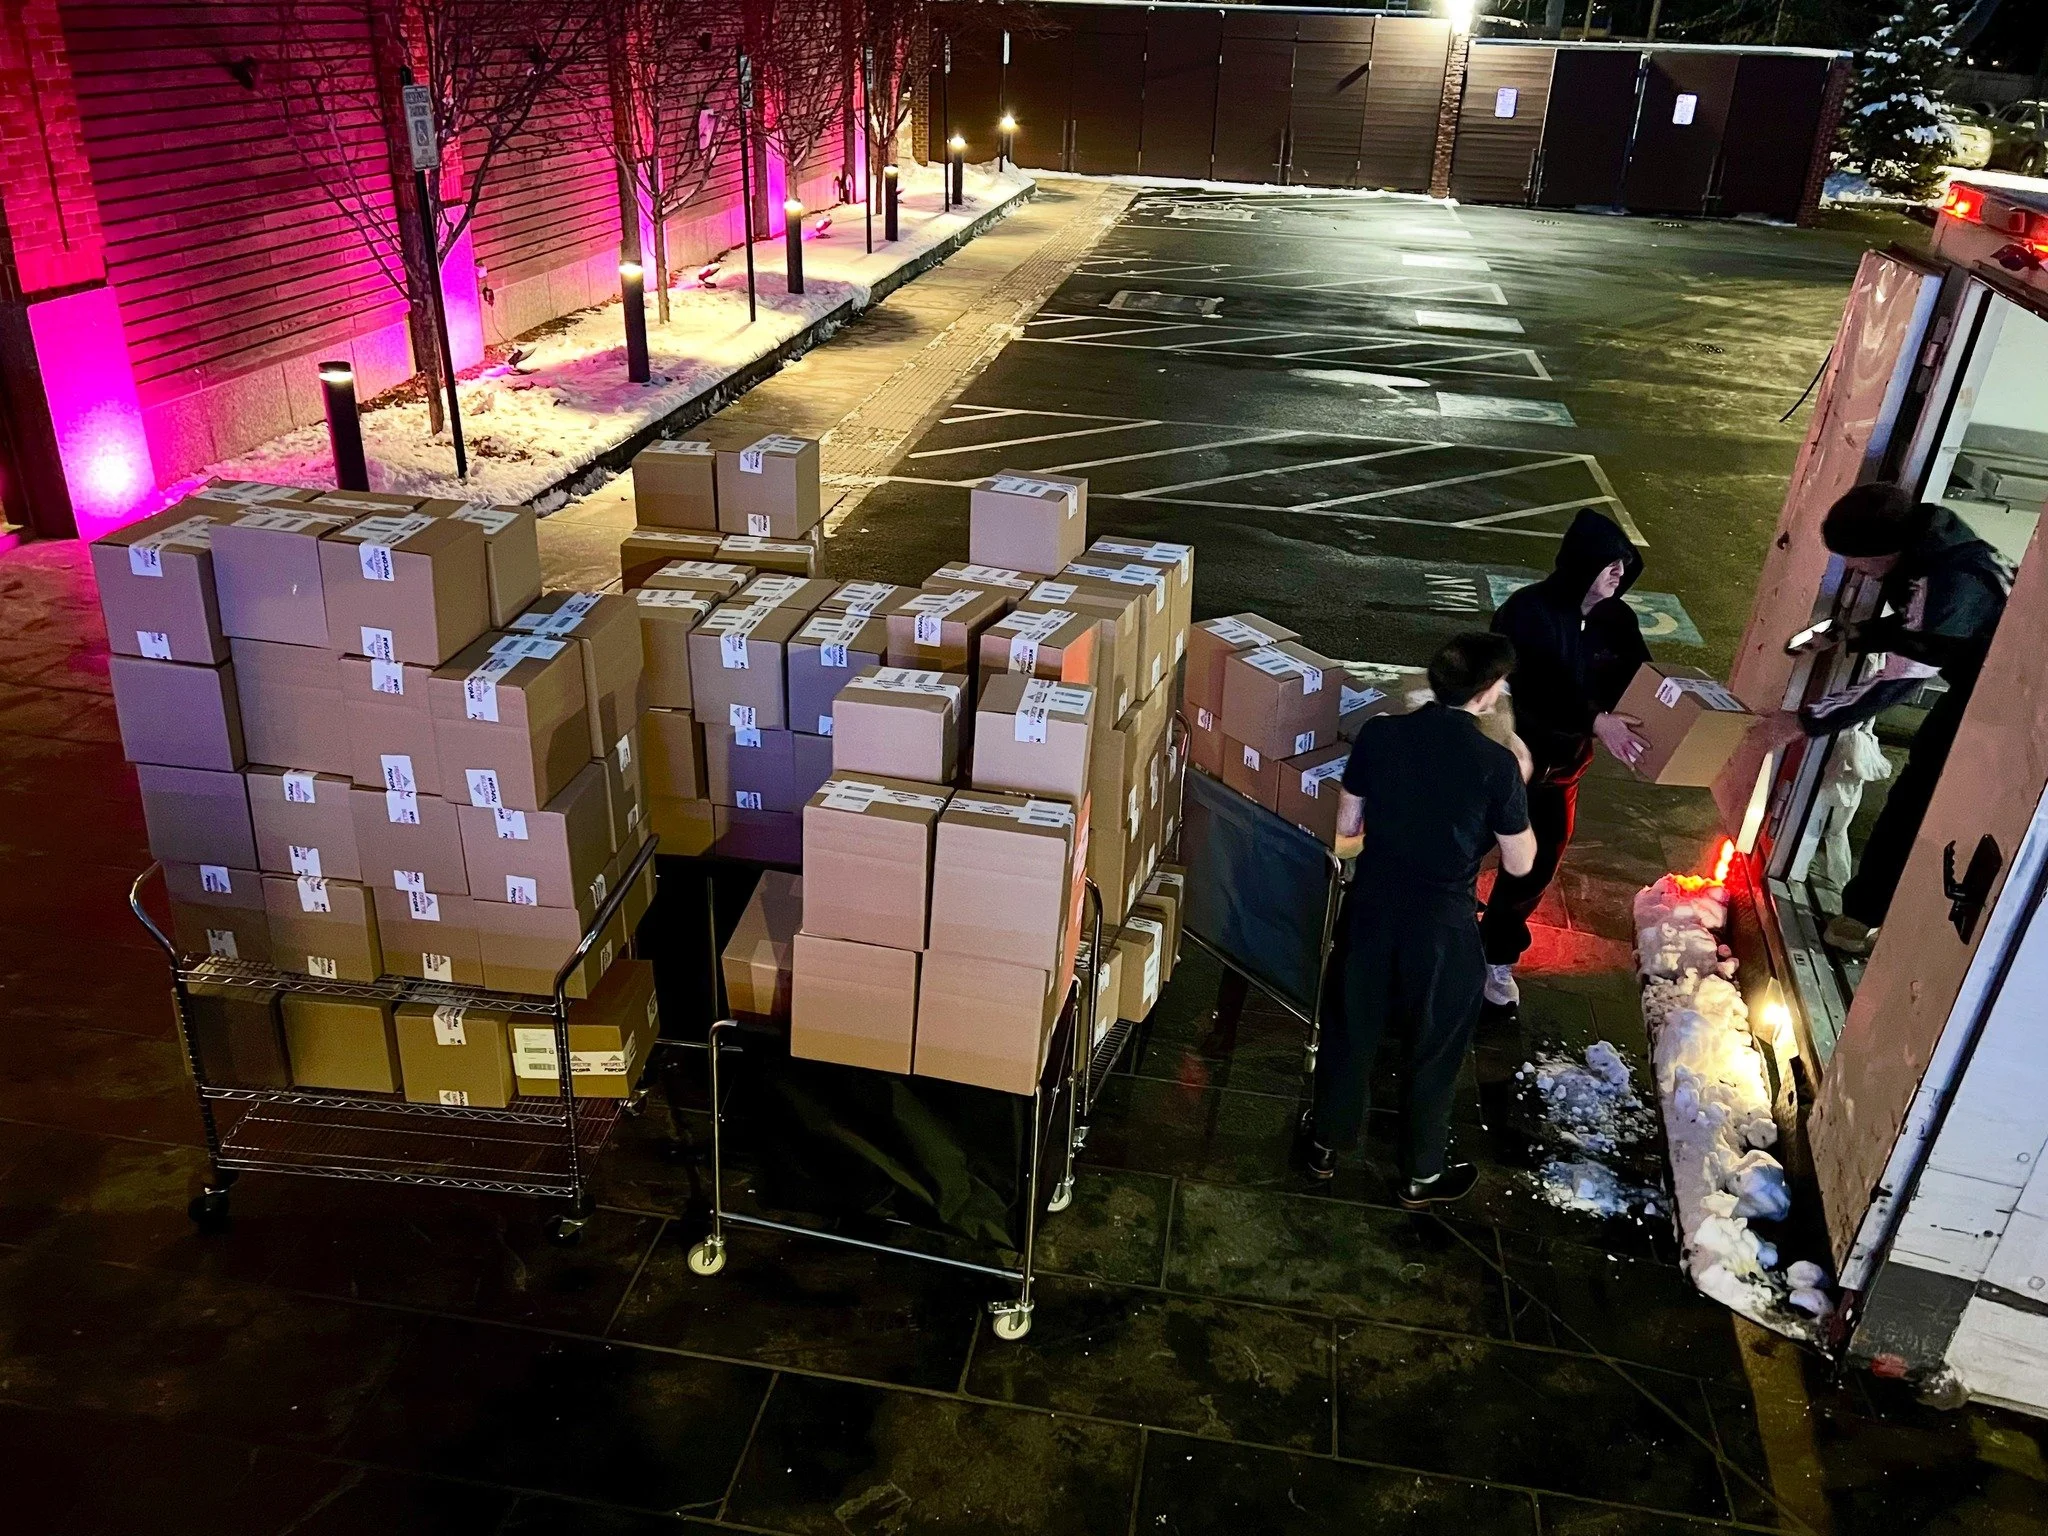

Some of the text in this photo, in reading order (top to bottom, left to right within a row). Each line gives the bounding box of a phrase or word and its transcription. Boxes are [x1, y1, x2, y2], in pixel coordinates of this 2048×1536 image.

[373, 547, 383, 579] ROSPECTOR
[380, 550, 390, 580] POPCORN
[487, 777, 497, 803] POPCORN
